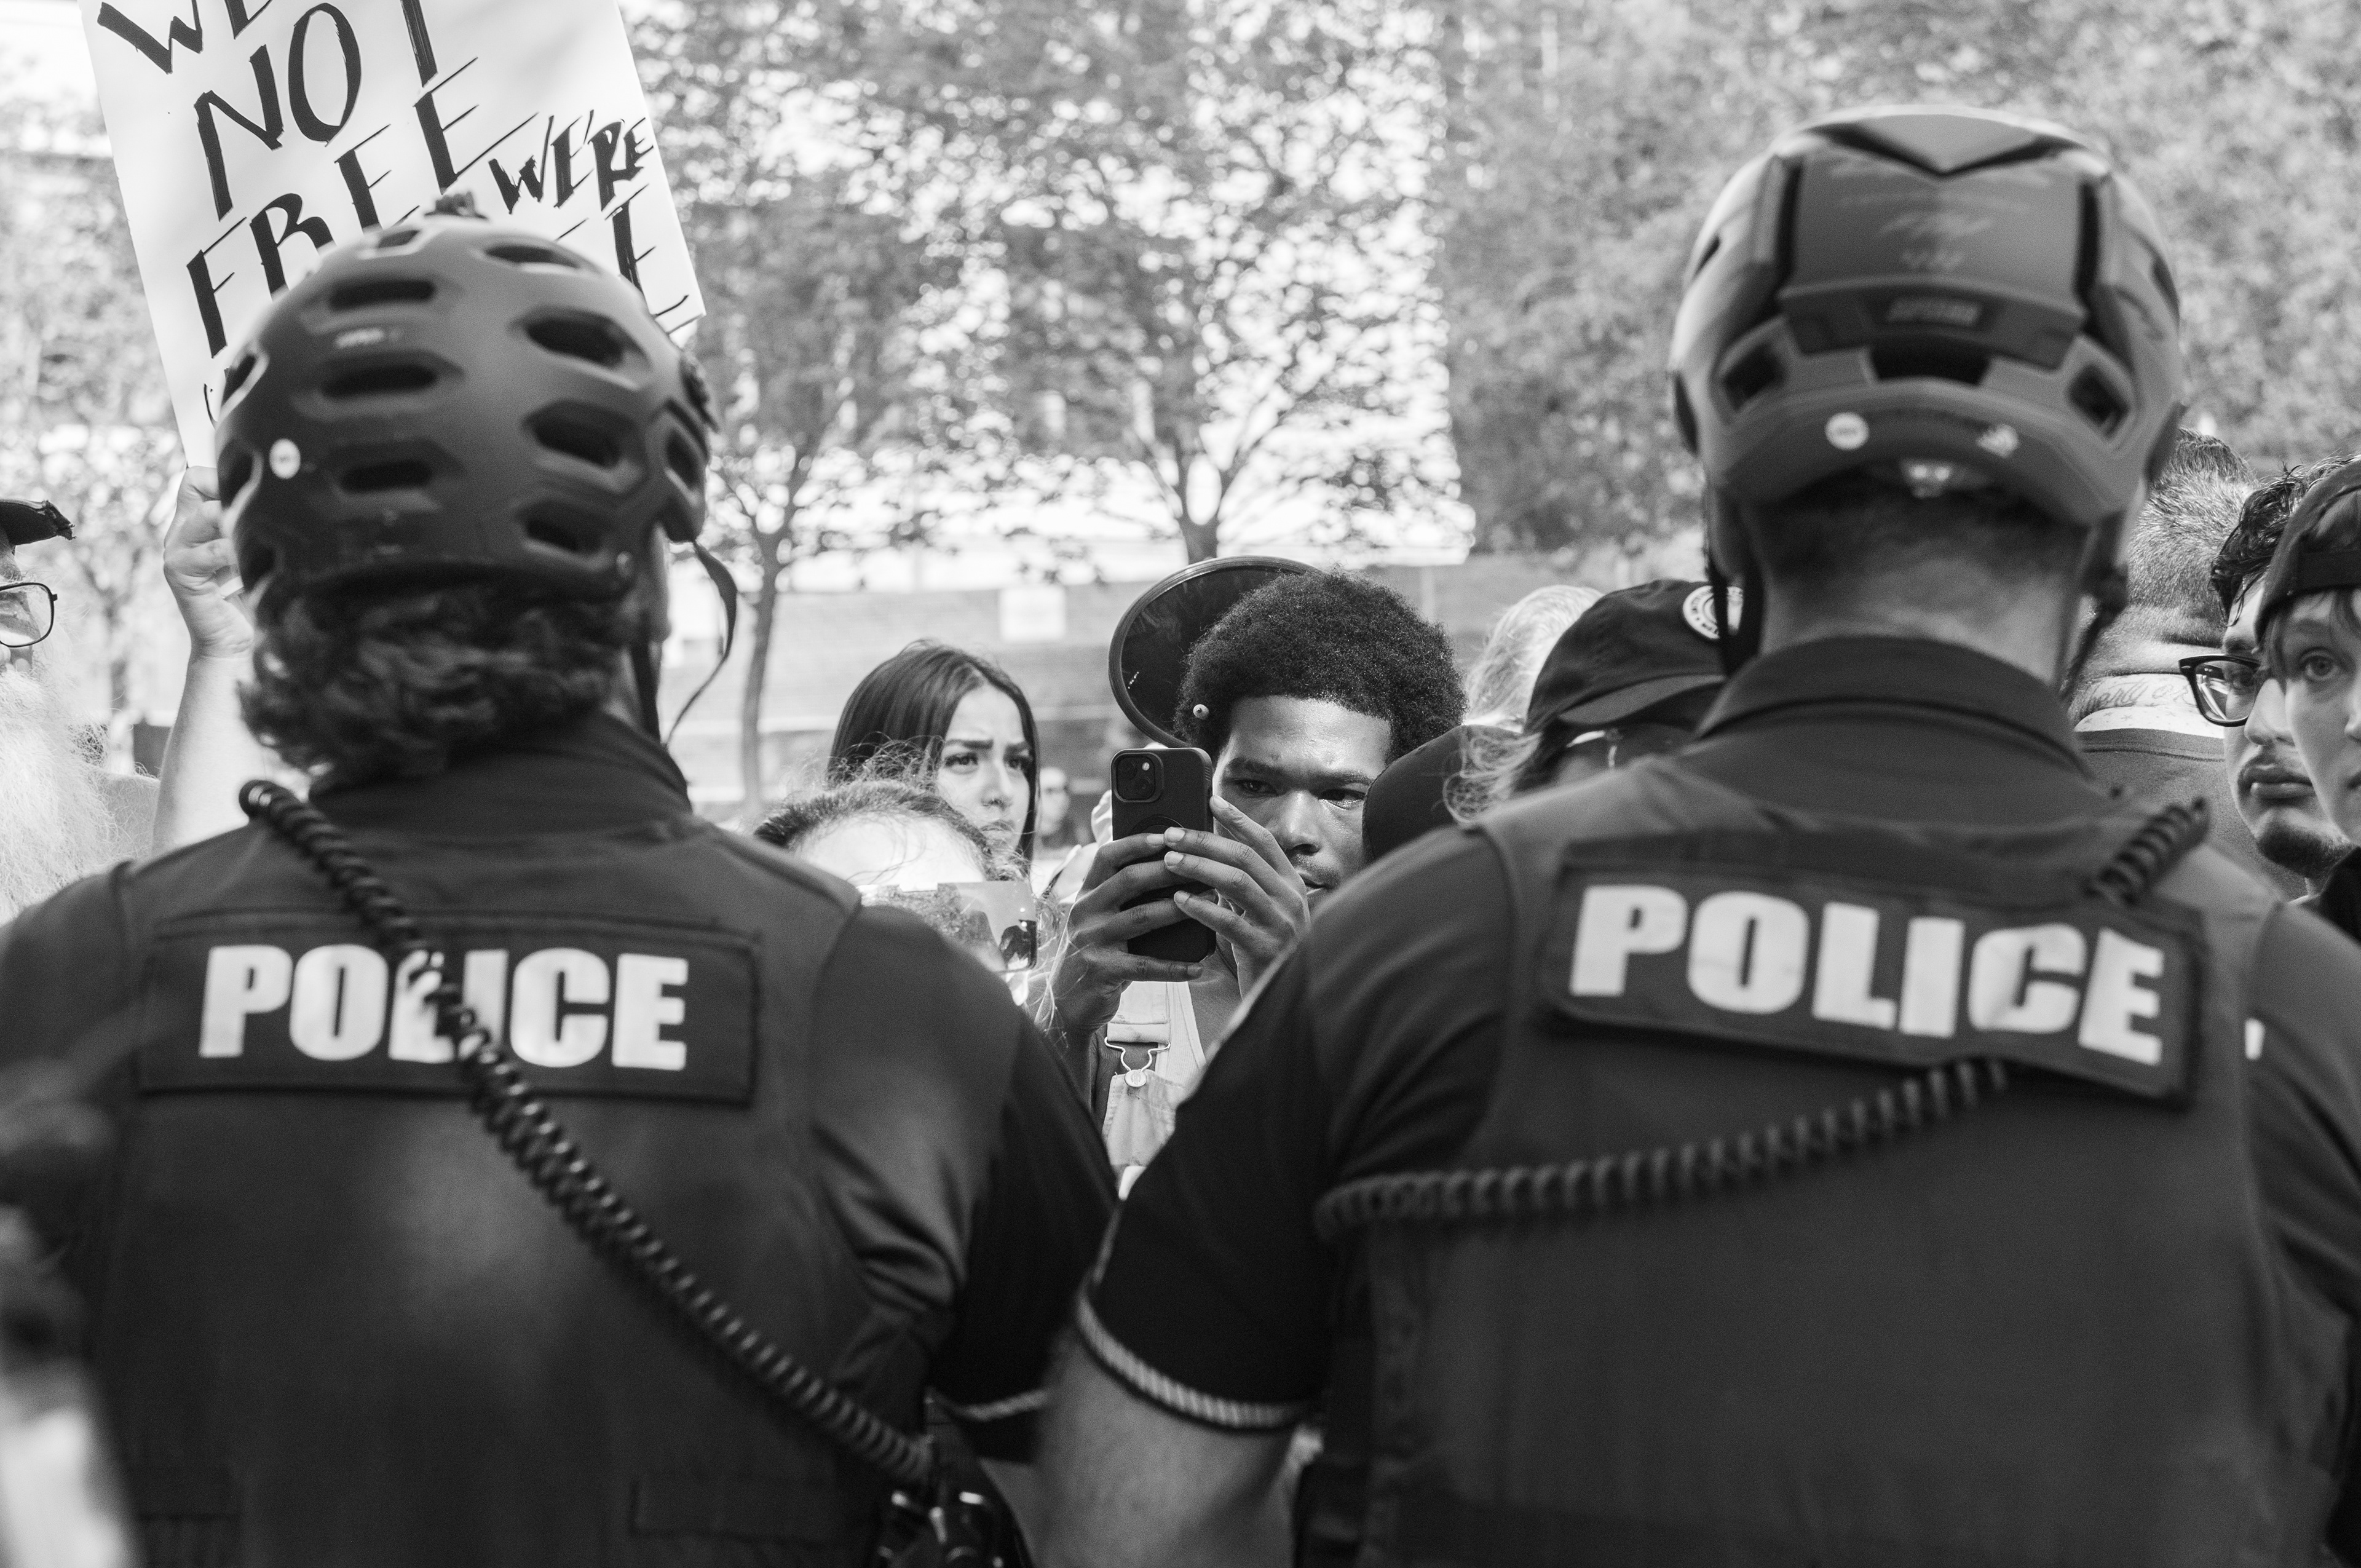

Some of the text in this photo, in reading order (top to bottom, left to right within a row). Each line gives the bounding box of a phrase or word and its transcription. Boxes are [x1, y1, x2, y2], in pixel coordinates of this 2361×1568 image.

[97, 0, 272, 74] W
[199, 943, 689, 1071] POLICE
[1570, 884, 2164, 1066] POLICE
